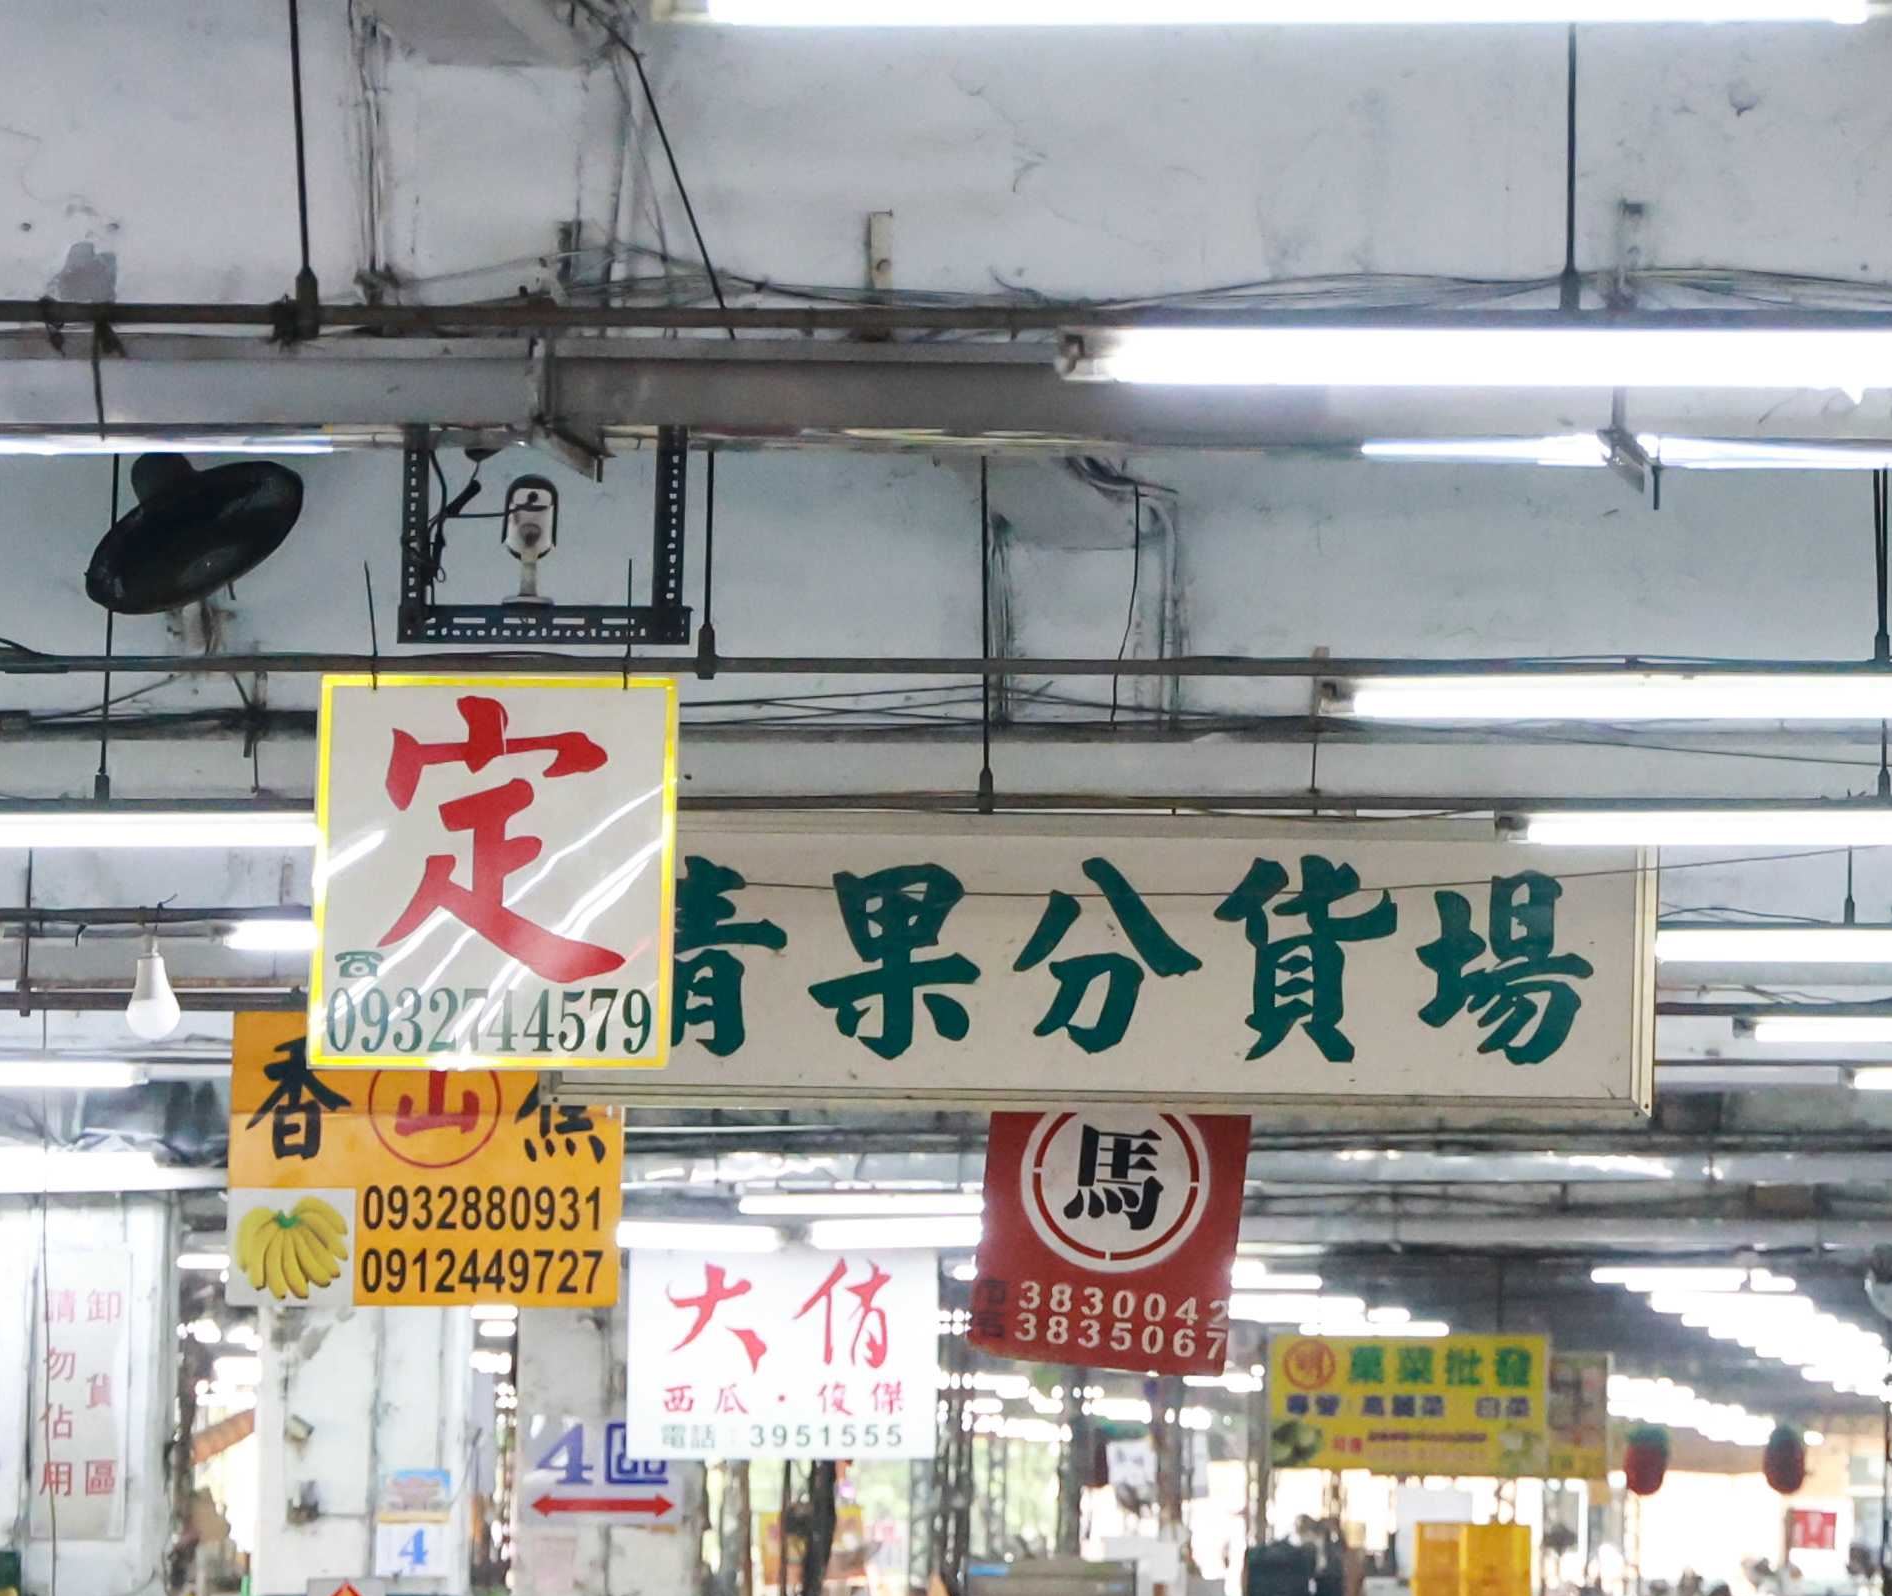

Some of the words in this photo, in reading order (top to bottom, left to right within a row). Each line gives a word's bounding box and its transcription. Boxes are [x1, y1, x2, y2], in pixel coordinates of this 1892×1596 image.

[379, 696, 626, 983] 定
[671, 853, 1593, 1065] 青果分貨場
[326, 988, 652, 1055] 0932744579
[1062, 1123, 1165, 1231] 馬
[363, 1186, 602, 1231] 0932880931
[362, 1248, 604, 1295] 0912449727
[1019, 1281, 1228, 1329] 3830042
[1014, 1312, 1227, 1360] 3835067
[399, 1528, 430, 1567] 4
